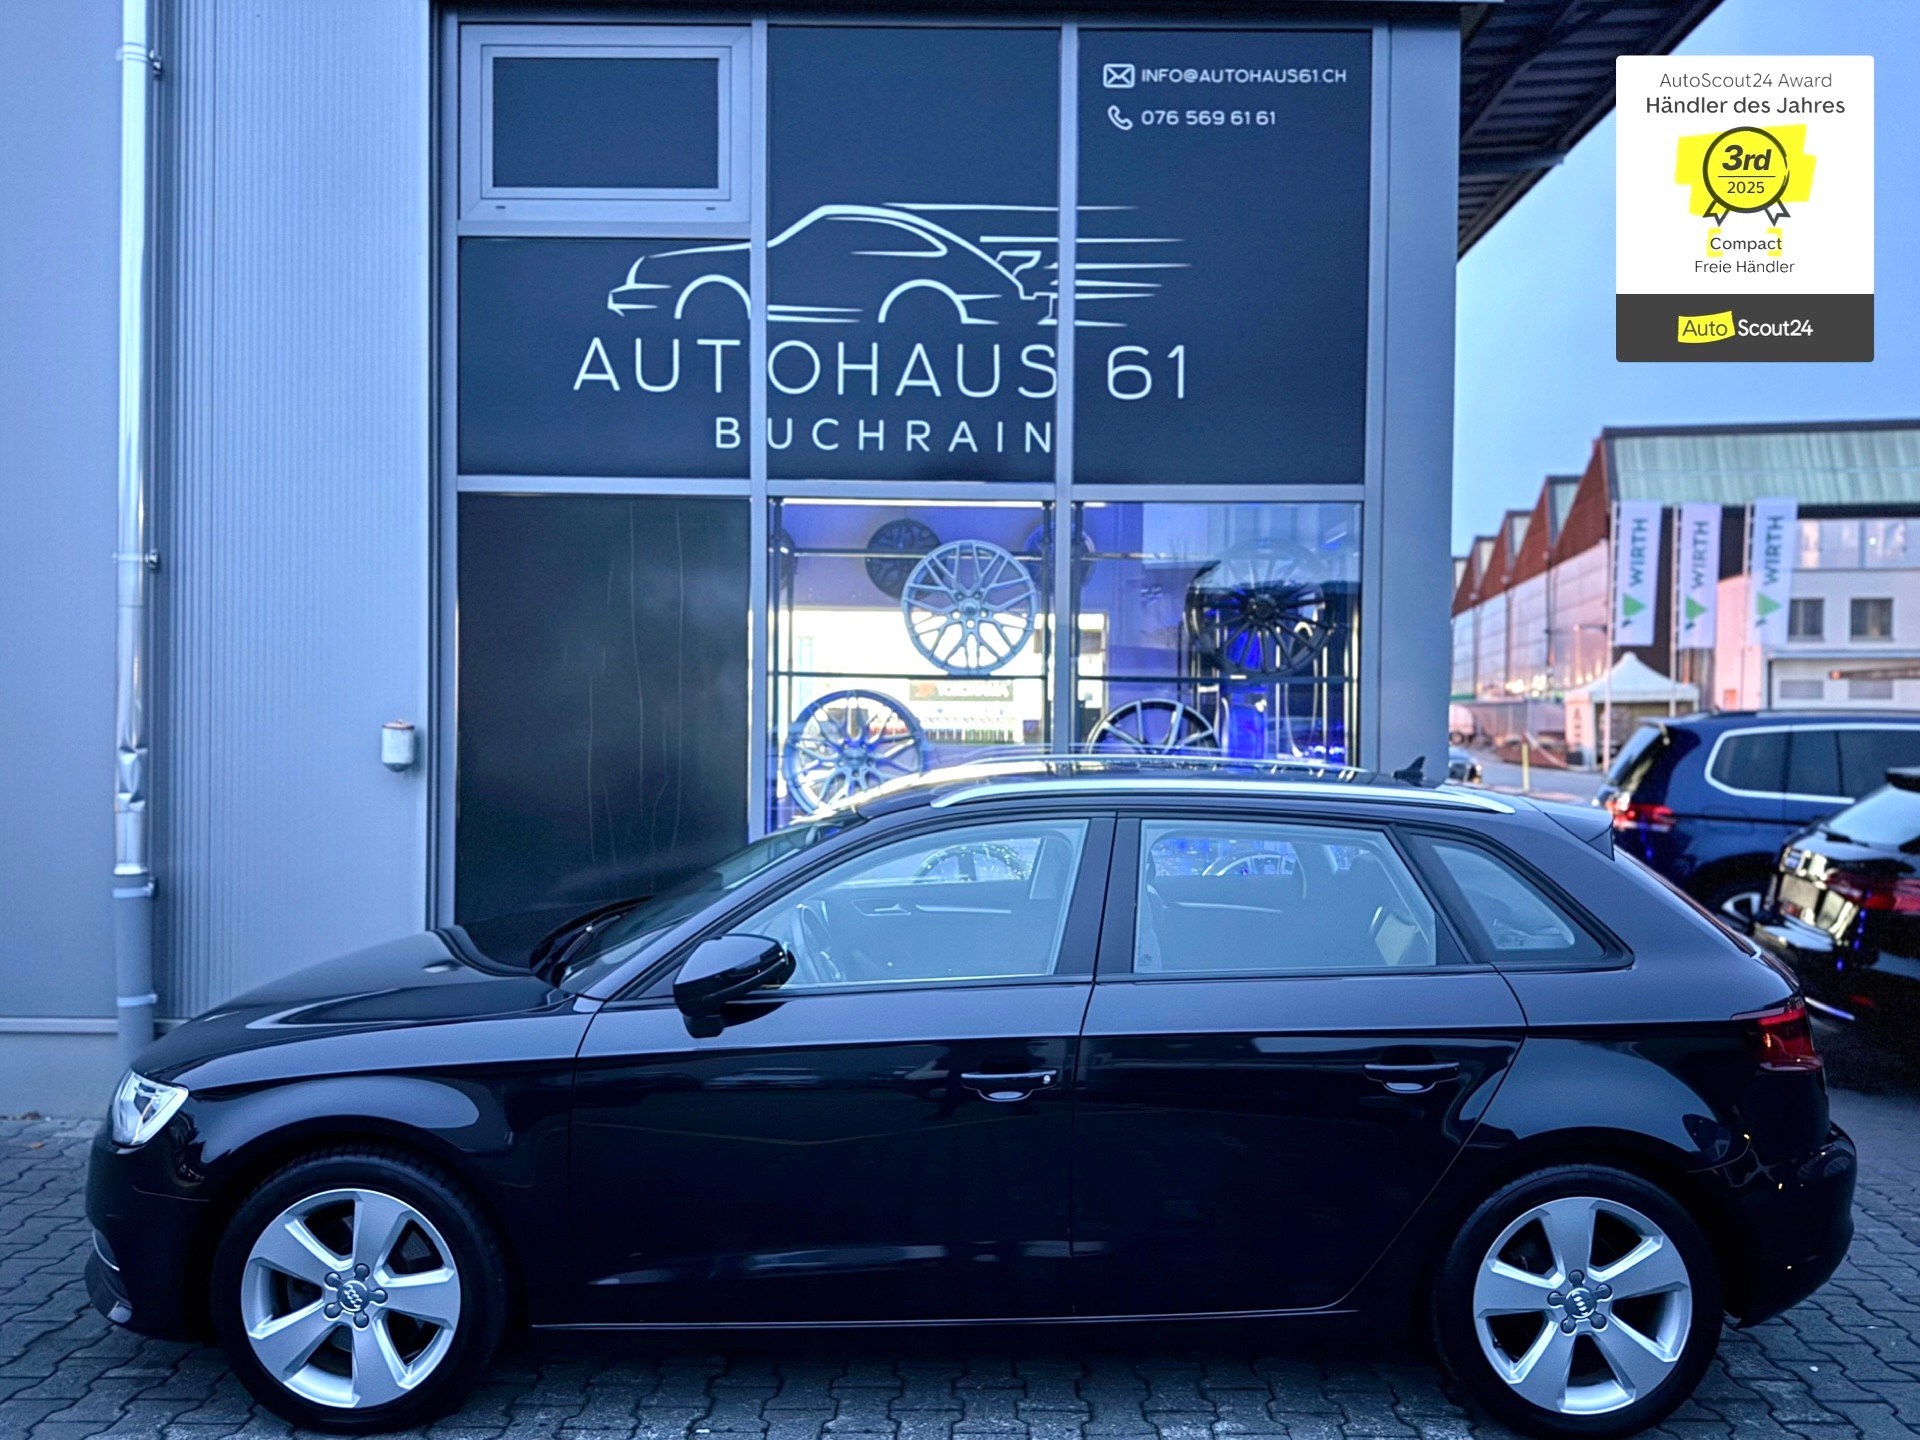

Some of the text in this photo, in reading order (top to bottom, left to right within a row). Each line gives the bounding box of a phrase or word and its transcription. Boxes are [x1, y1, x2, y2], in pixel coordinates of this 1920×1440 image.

[1141, 68, 1347, 83] INFO@AUTOHAUS61.CH
[1141, 110, 1275, 126] 076 569 61 61
[573, 337, 1187, 400] AUTOHAUS 61
[715, 416, 1052, 453] BUCHRAIN
[1629, 517, 1648, 587] WIRTH
[1692, 520, 1708, 590] WIRTH
[1764, 515, 1784, 586] WIRTH
